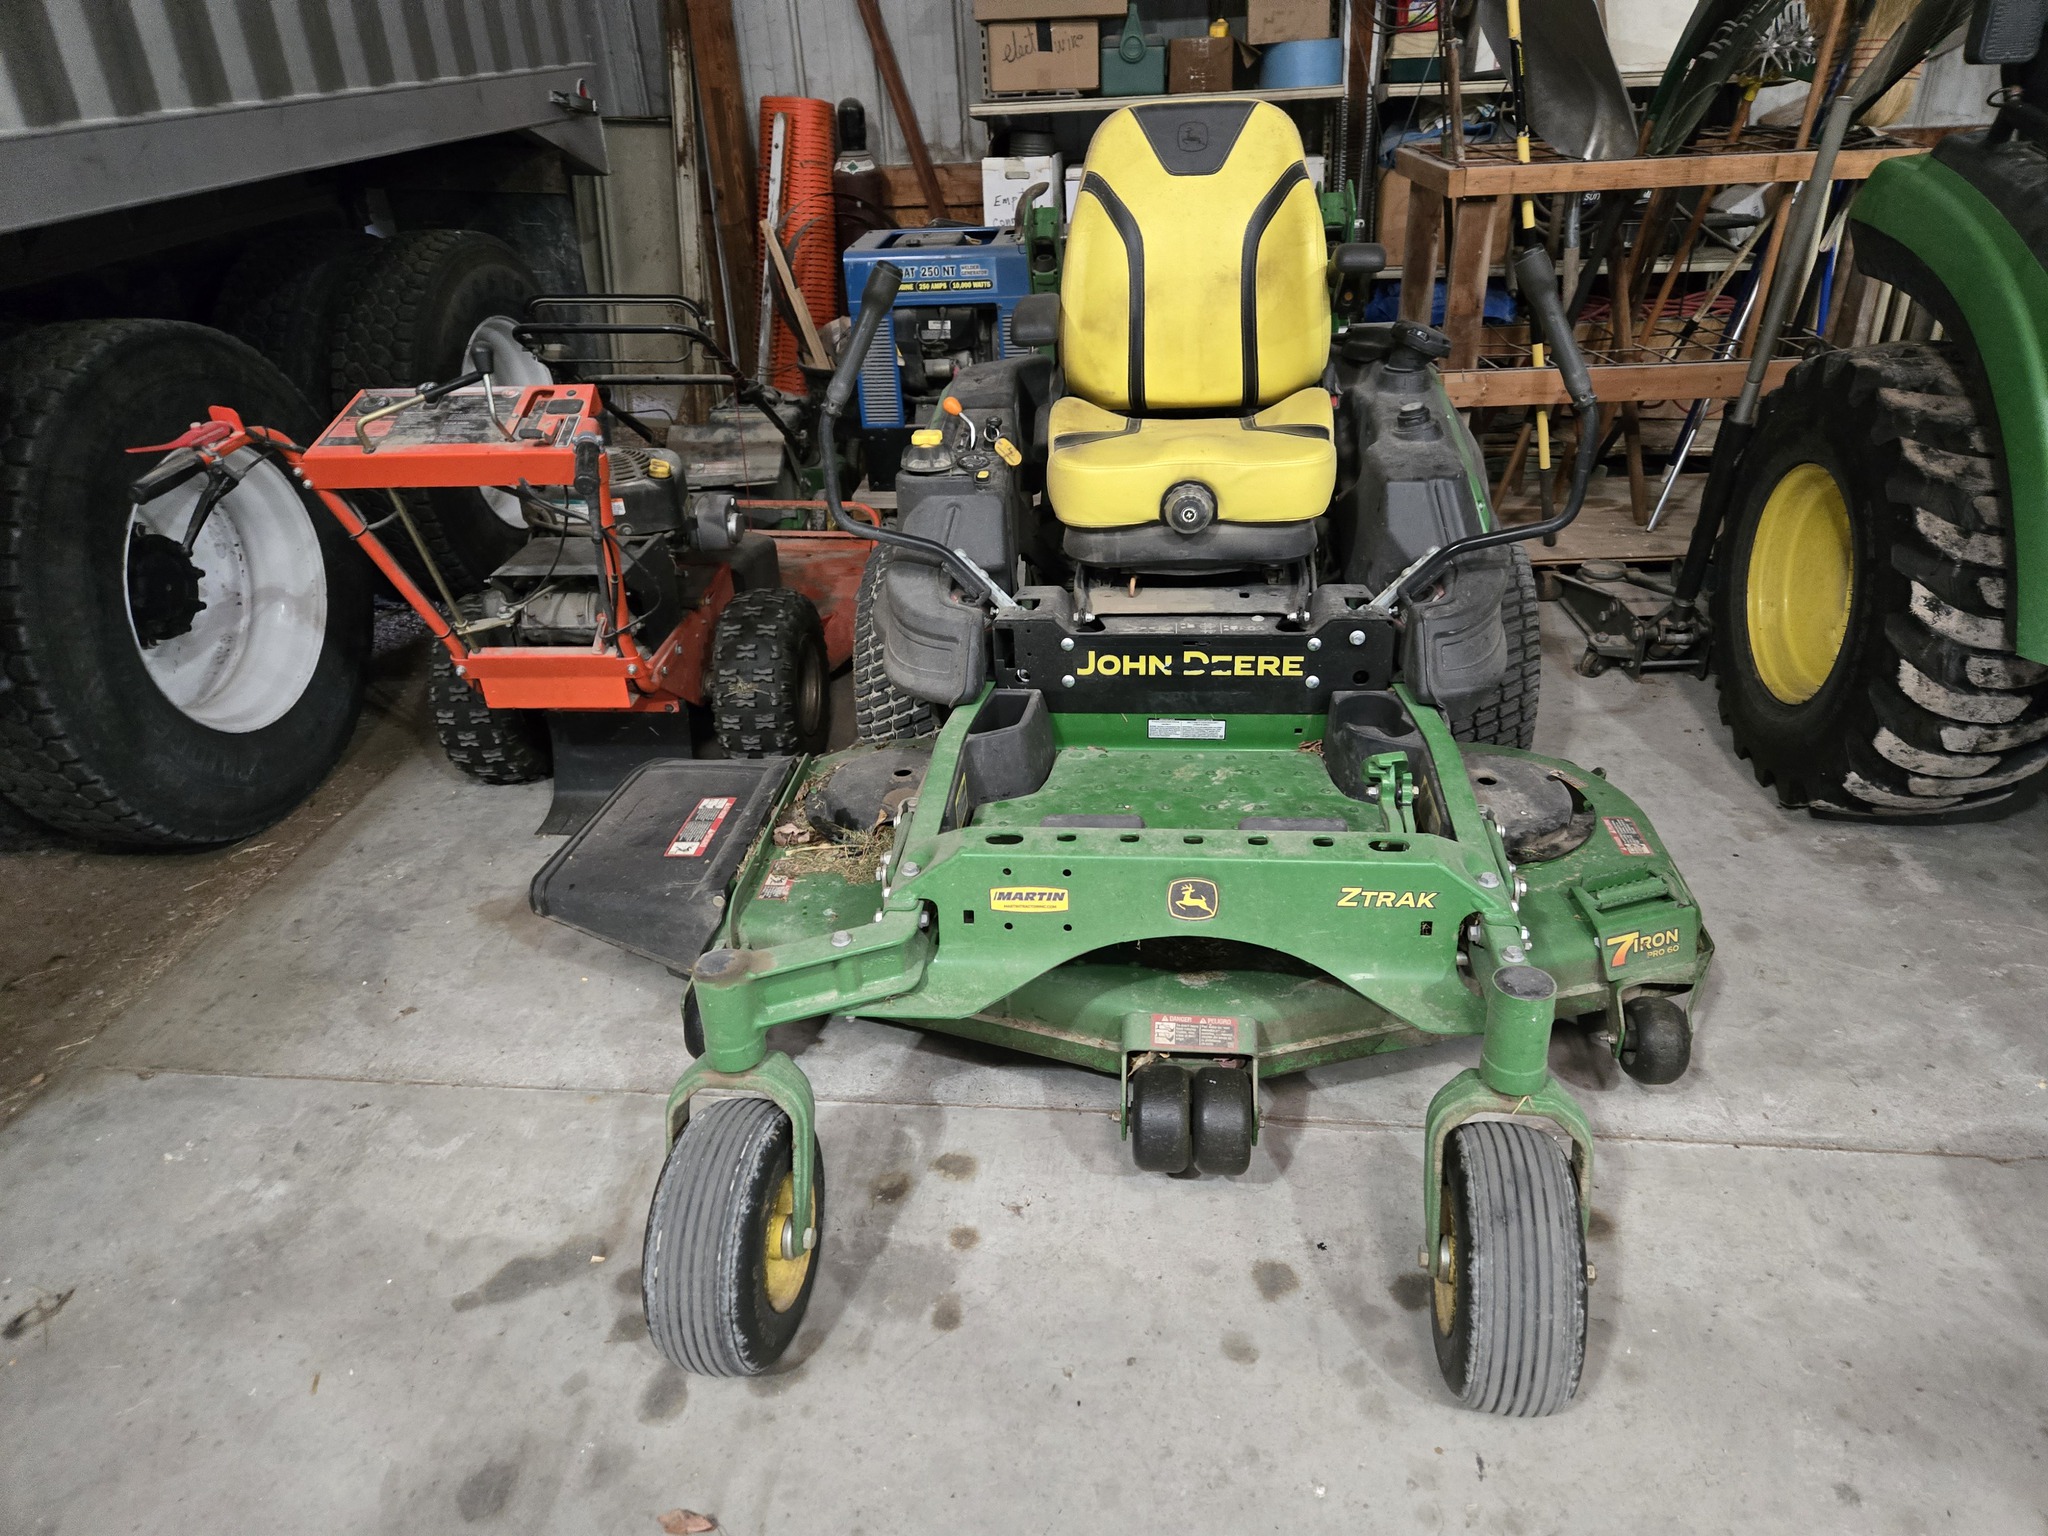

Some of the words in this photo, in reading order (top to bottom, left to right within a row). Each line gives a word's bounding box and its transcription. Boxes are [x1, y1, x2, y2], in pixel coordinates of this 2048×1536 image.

[994, 195, 1017, 212] Emp
[903, 266, 916, 278] AT
[921, 266, 940, 277] 250
[943, 266, 956, 277] NT
[931, 282, 948, 290] AMPS
[972, 280, 991, 289] WATTS
[1076, 650, 1172, 676] JOHN
[1183, 651, 1305, 676] DEERE
[993, 891, 1066, 902] MARTIN
[1336, 886, 1440, 909] ZTRAK
[1633, 928, 1680, 954] IRON
[1646, 948, 1665, 959] PRO
[1169, 1015, 1192, 1023] DANGER
